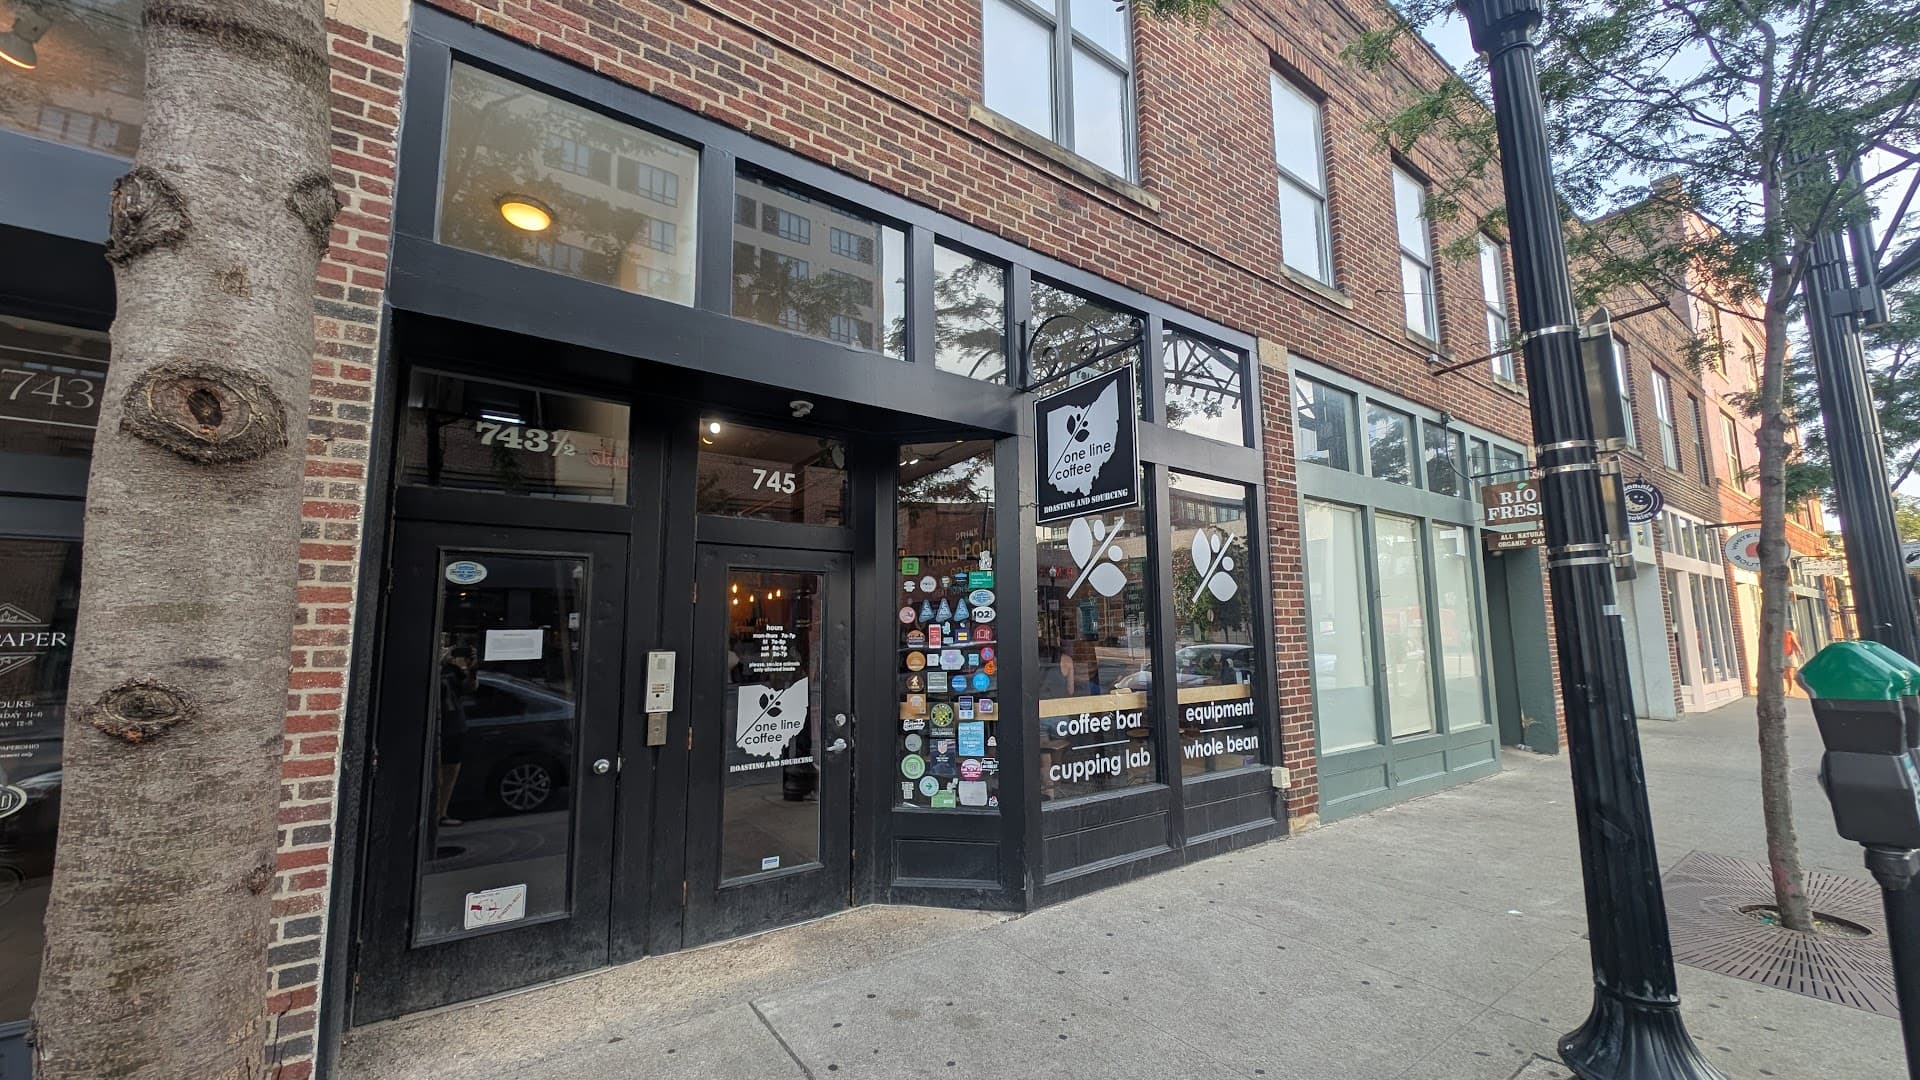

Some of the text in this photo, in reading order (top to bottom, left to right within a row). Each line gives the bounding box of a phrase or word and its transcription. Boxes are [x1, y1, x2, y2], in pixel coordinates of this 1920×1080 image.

[2, 369, 95, 409] 743
[1064, 441, 1111, 464] one line
[752, 468, 796, 494] 745
[1055, 462, 1092, 481] coffee
[1043, 488, 1129, 514] ROASTING AND SOURCING
[1498, 540, 1527, 548] ORGANIC
[1517, 531, 1545, 539] NATURA
[1734, 555, 1760, 567] BOUT
[0, 632, 67, 647] APER
[0, 701, 34, 709] OURS:
[1185, 698, 1254, 724] equipment
[754, 719, 801, 732] one line
[1056, 710, 1143, 737] coffee bar
[744, 732, 783, 745] coffee
[1183, 735, 1259, 760] whole bean
[729, 762, 765, 773] ROASTING
[766, 760, 780, 769] AND
[1049, 747, 1151, 783] cupping lab
